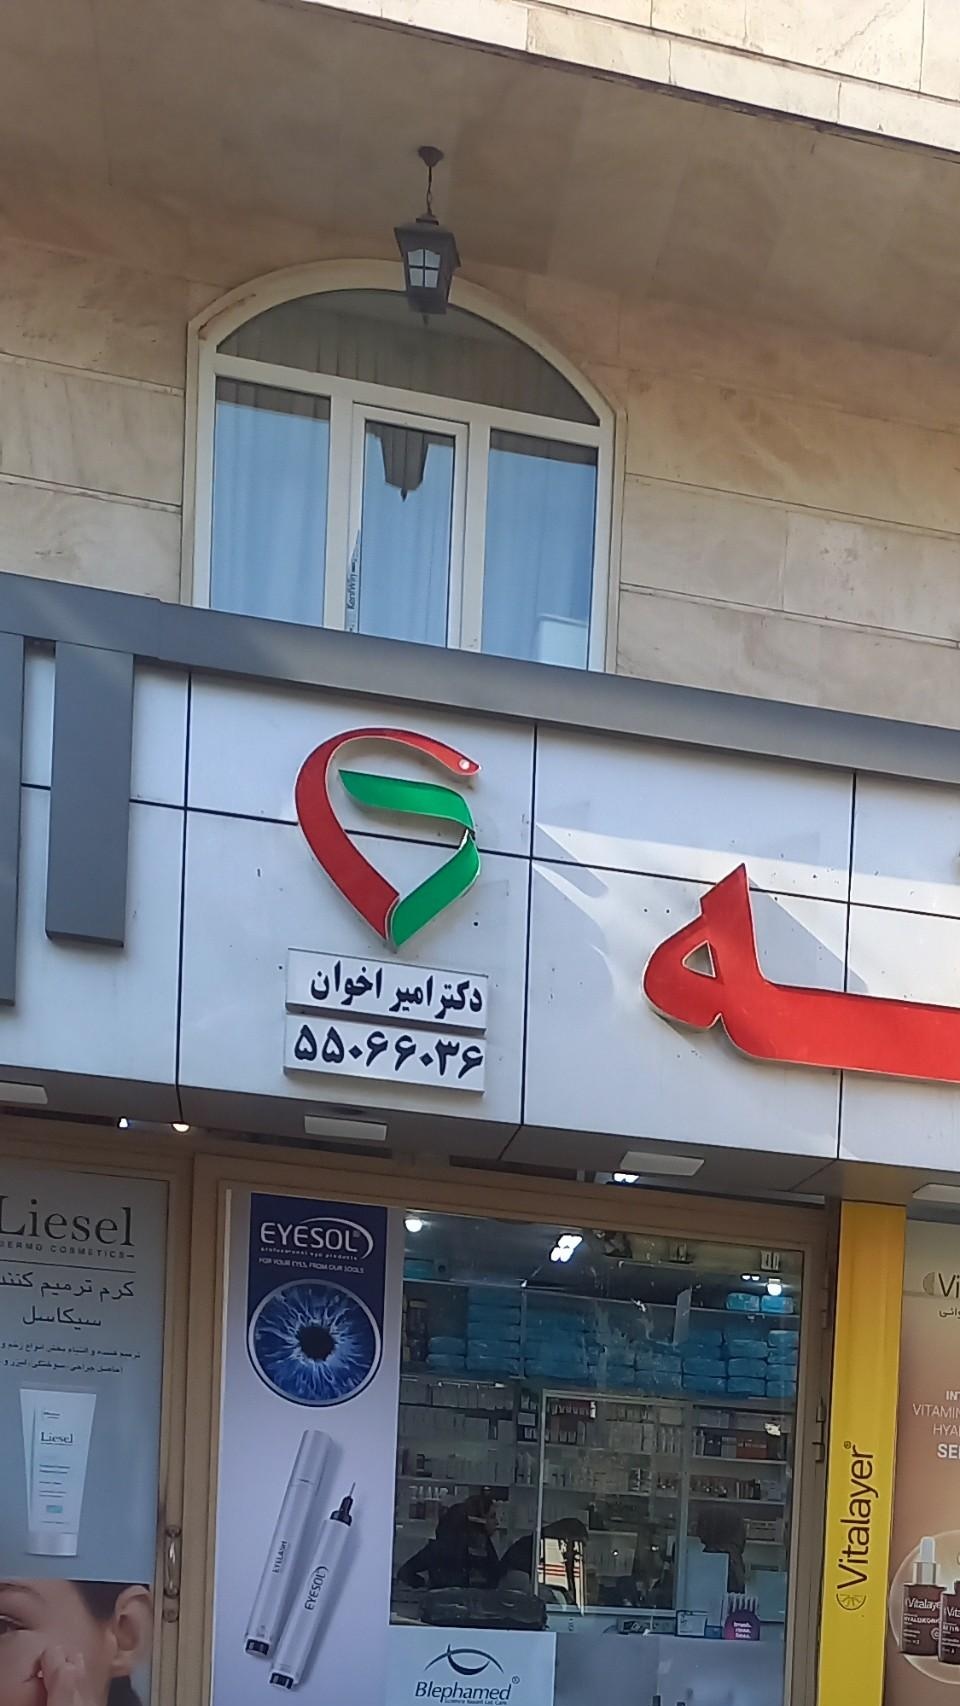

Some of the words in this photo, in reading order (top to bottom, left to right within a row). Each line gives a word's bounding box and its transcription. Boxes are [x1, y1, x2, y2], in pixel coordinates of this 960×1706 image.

[311, 960, 383, 1005] اخوان
[388, 975, 434, 1012] امیر
[434, 980, 483, 1019] دکتر
[294, 1024, 484, 1079] ۵۵۰۶۶۰۳۶
[0, 1195, 135, 1247] Liesel
[260, 1222, 358, 1252] EYESOL
[50, 1245, 125, 1259] COSMETICS
[0, 1271, 33, 1288] کنند
[40, 1278, 93, 1297] ترمیم
[100, 1281, 134, 1302] کرم
[23, 1305, 102, 1330] سیکاسل
[40, 1431, 74, 1444] Liesel
[837, 1444, 879, 1590] Vitalayer
[304, 1568, 328, 1610] EYESOL
[908, 1598, 940, 1612] Vitalaye
[415, 1681, 512, 1703] Blephamed
